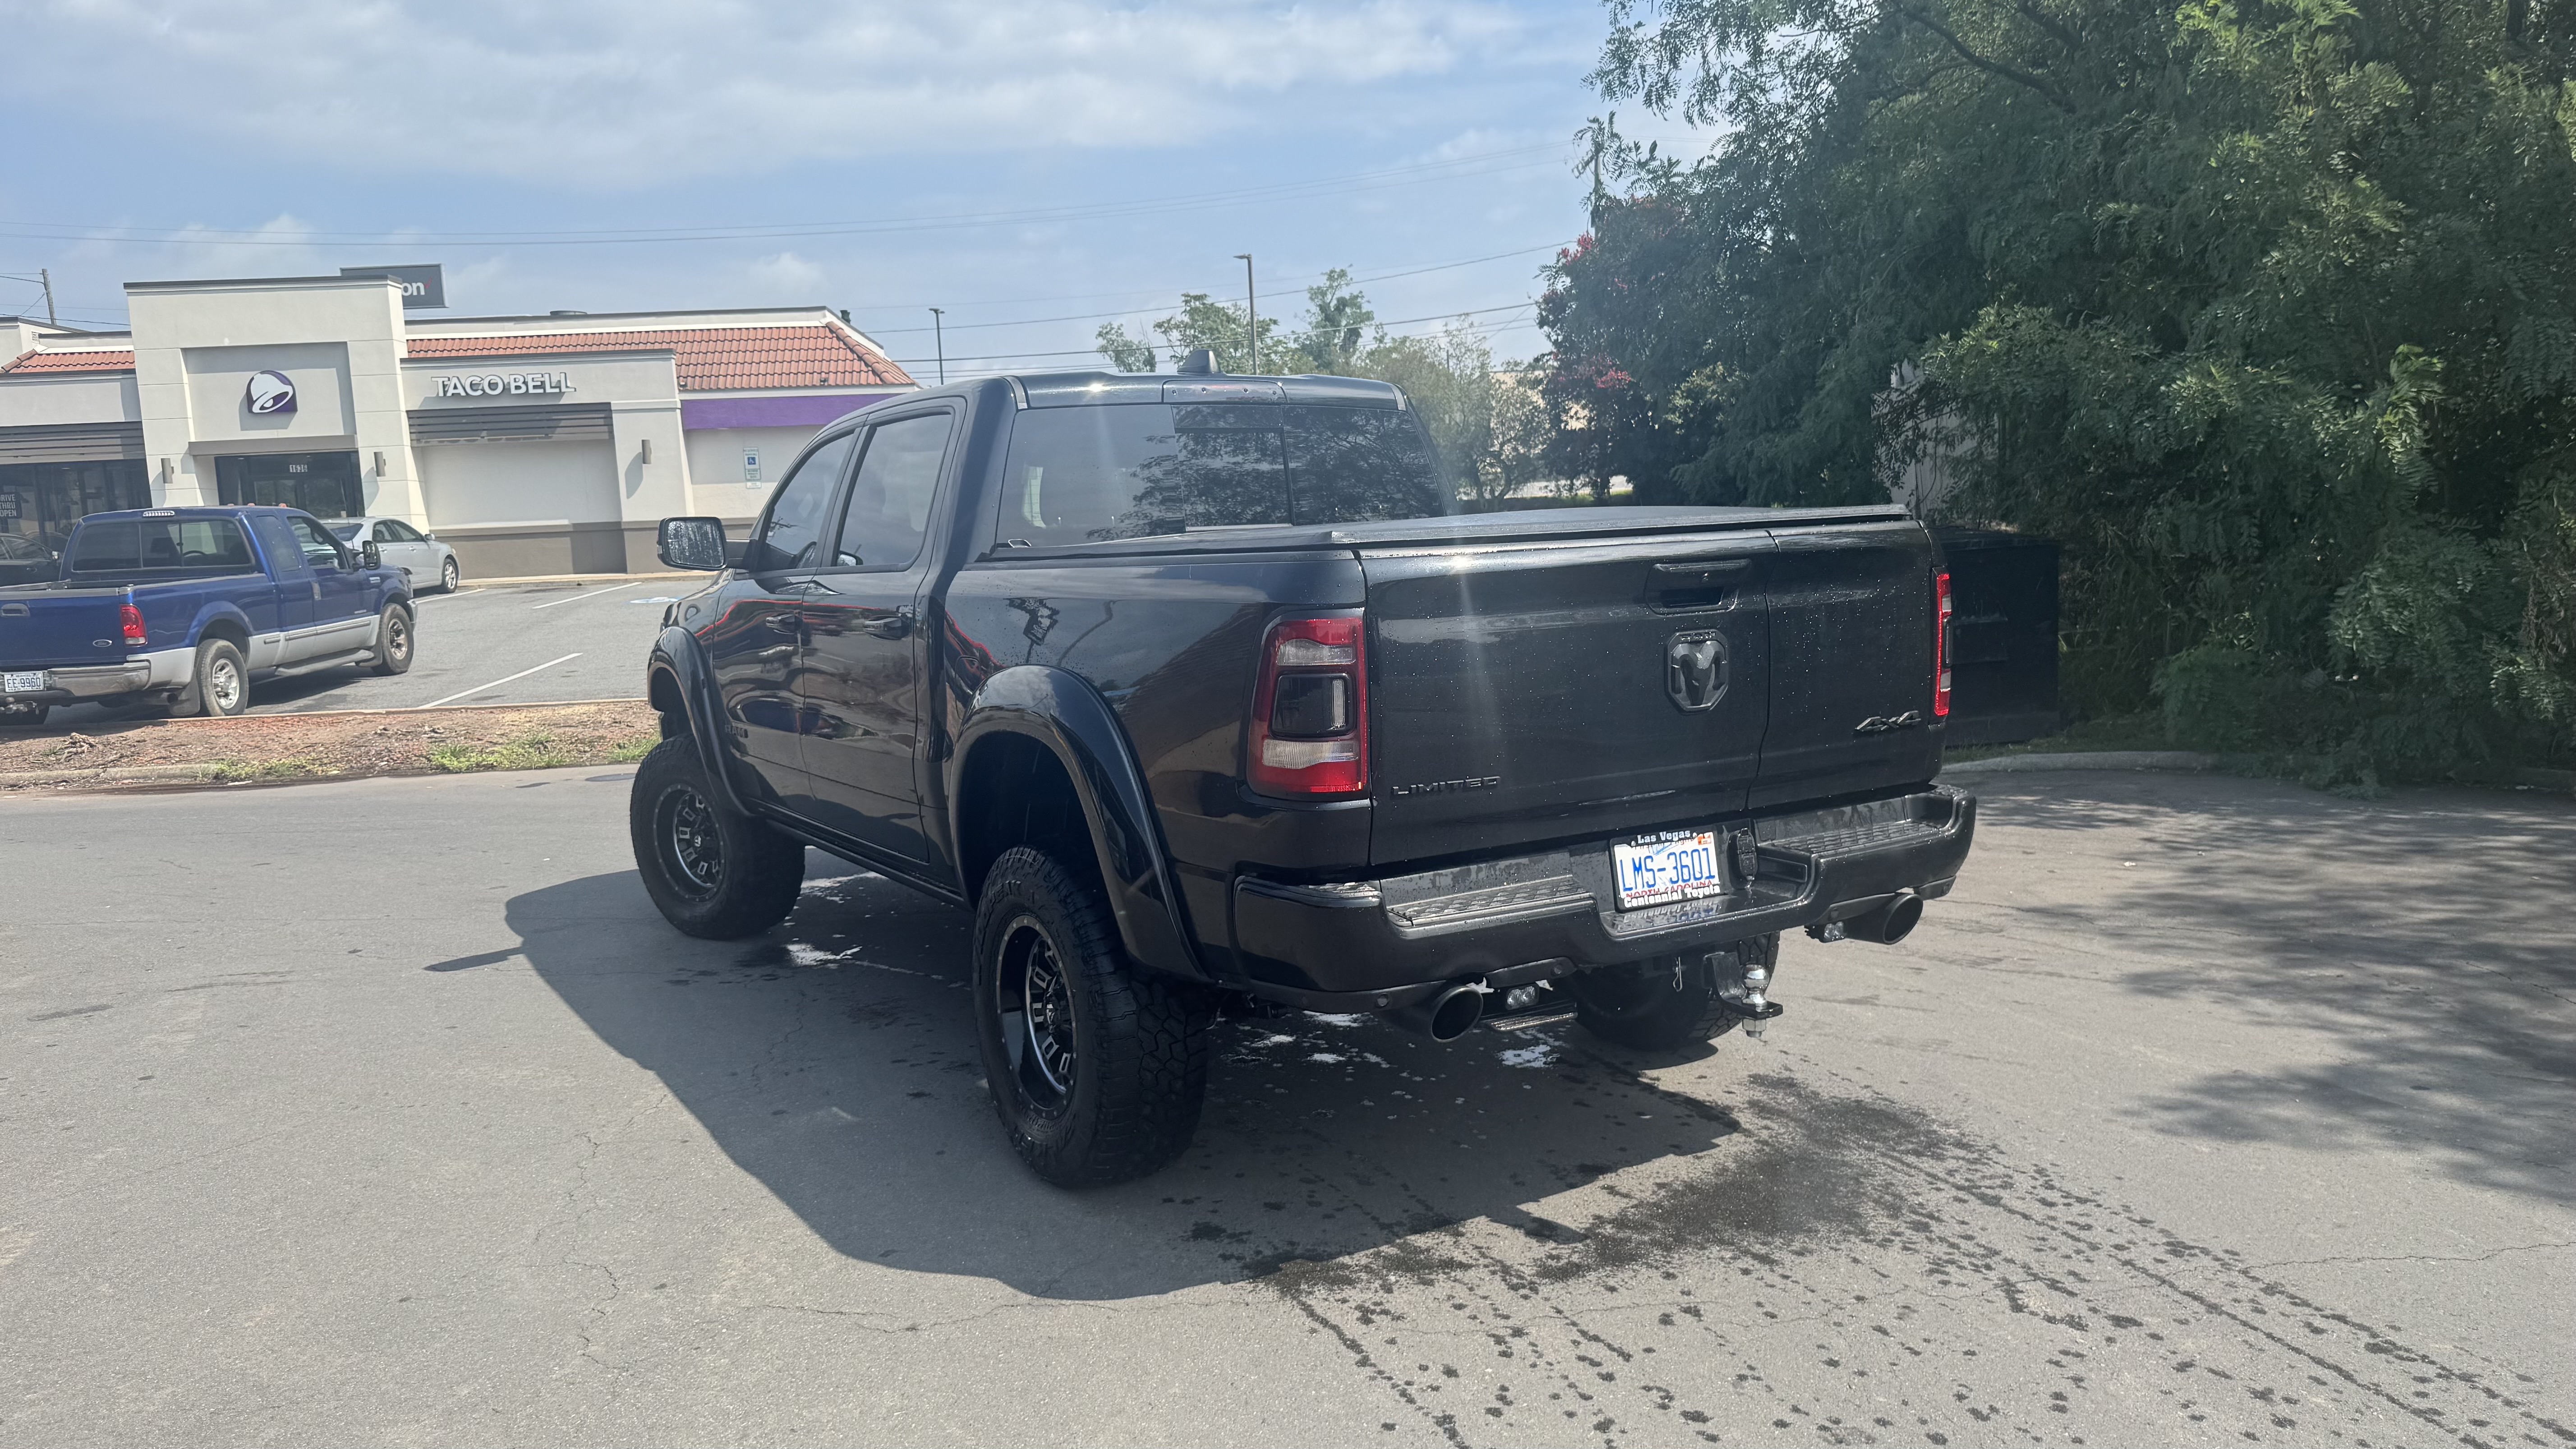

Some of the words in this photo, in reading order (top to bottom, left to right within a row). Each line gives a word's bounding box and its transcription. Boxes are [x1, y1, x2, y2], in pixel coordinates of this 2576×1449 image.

[431, 375, 505, 397] TACO
[509, 373, 576, 394] BELL
[7, 677, 41, 688] EE-9960
[1391, 776, 1501, 796] LIMITED
[1637, 834, 1656, 844] Las
[1659, 830, 1691, 842] Vegas
[1619, 847, 1716, 892] LMS-3601
[1624, 889, 1682, 908] Centennial
[1684, 884, 1720, 899] Toyota
